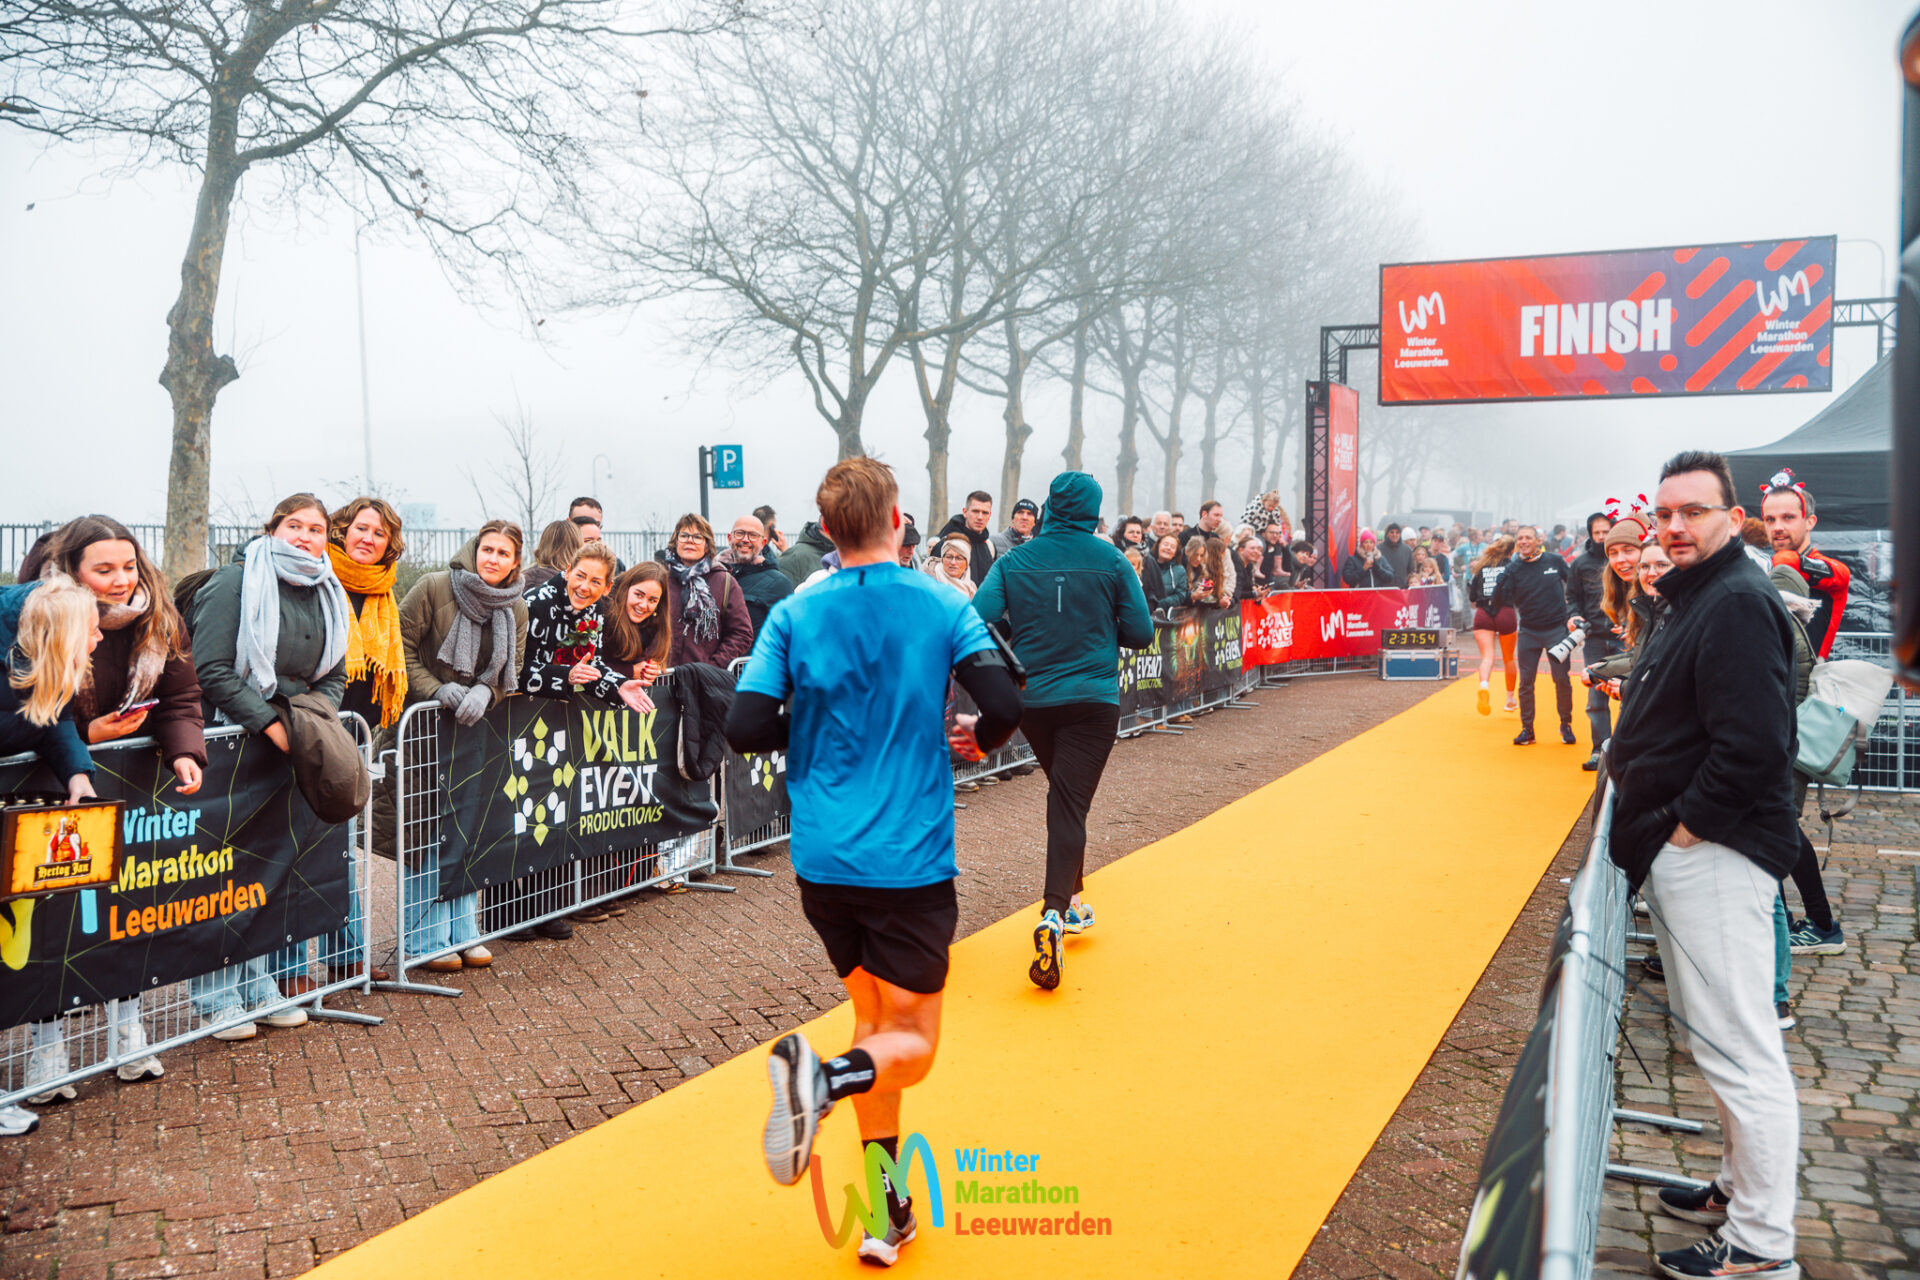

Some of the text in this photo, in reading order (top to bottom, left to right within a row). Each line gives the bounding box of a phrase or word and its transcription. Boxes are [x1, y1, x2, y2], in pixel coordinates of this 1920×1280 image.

[1520, 298, 1672, 357] FINISH
[1765, 320, 1800, 329] Winter
[1407, 337, 1437, 346] Winter
[1757, 330, 1808, 342] Marathon
[1400, 347, 1443, 357] Marathon
[1750, 341, 1814, 354] Leeuwarden
[1394, 357, 1449, 368] Leeuwarden
[723, 449, 737, 472] P
[1389, 633, 1436, 645] 2:37:54
[1136, 655, 1162, 680] EVENT
[581, 708, 658, 763] VALK
[581, 764, 661, 813] EVENT
[579, 804, 664, 836] PRODUCTIONS
[38, 862, 90, 880] Hertog Jan
[111, 844, 234, 894] Marathon
[109, 879, 267, 941] Leeuwarden
